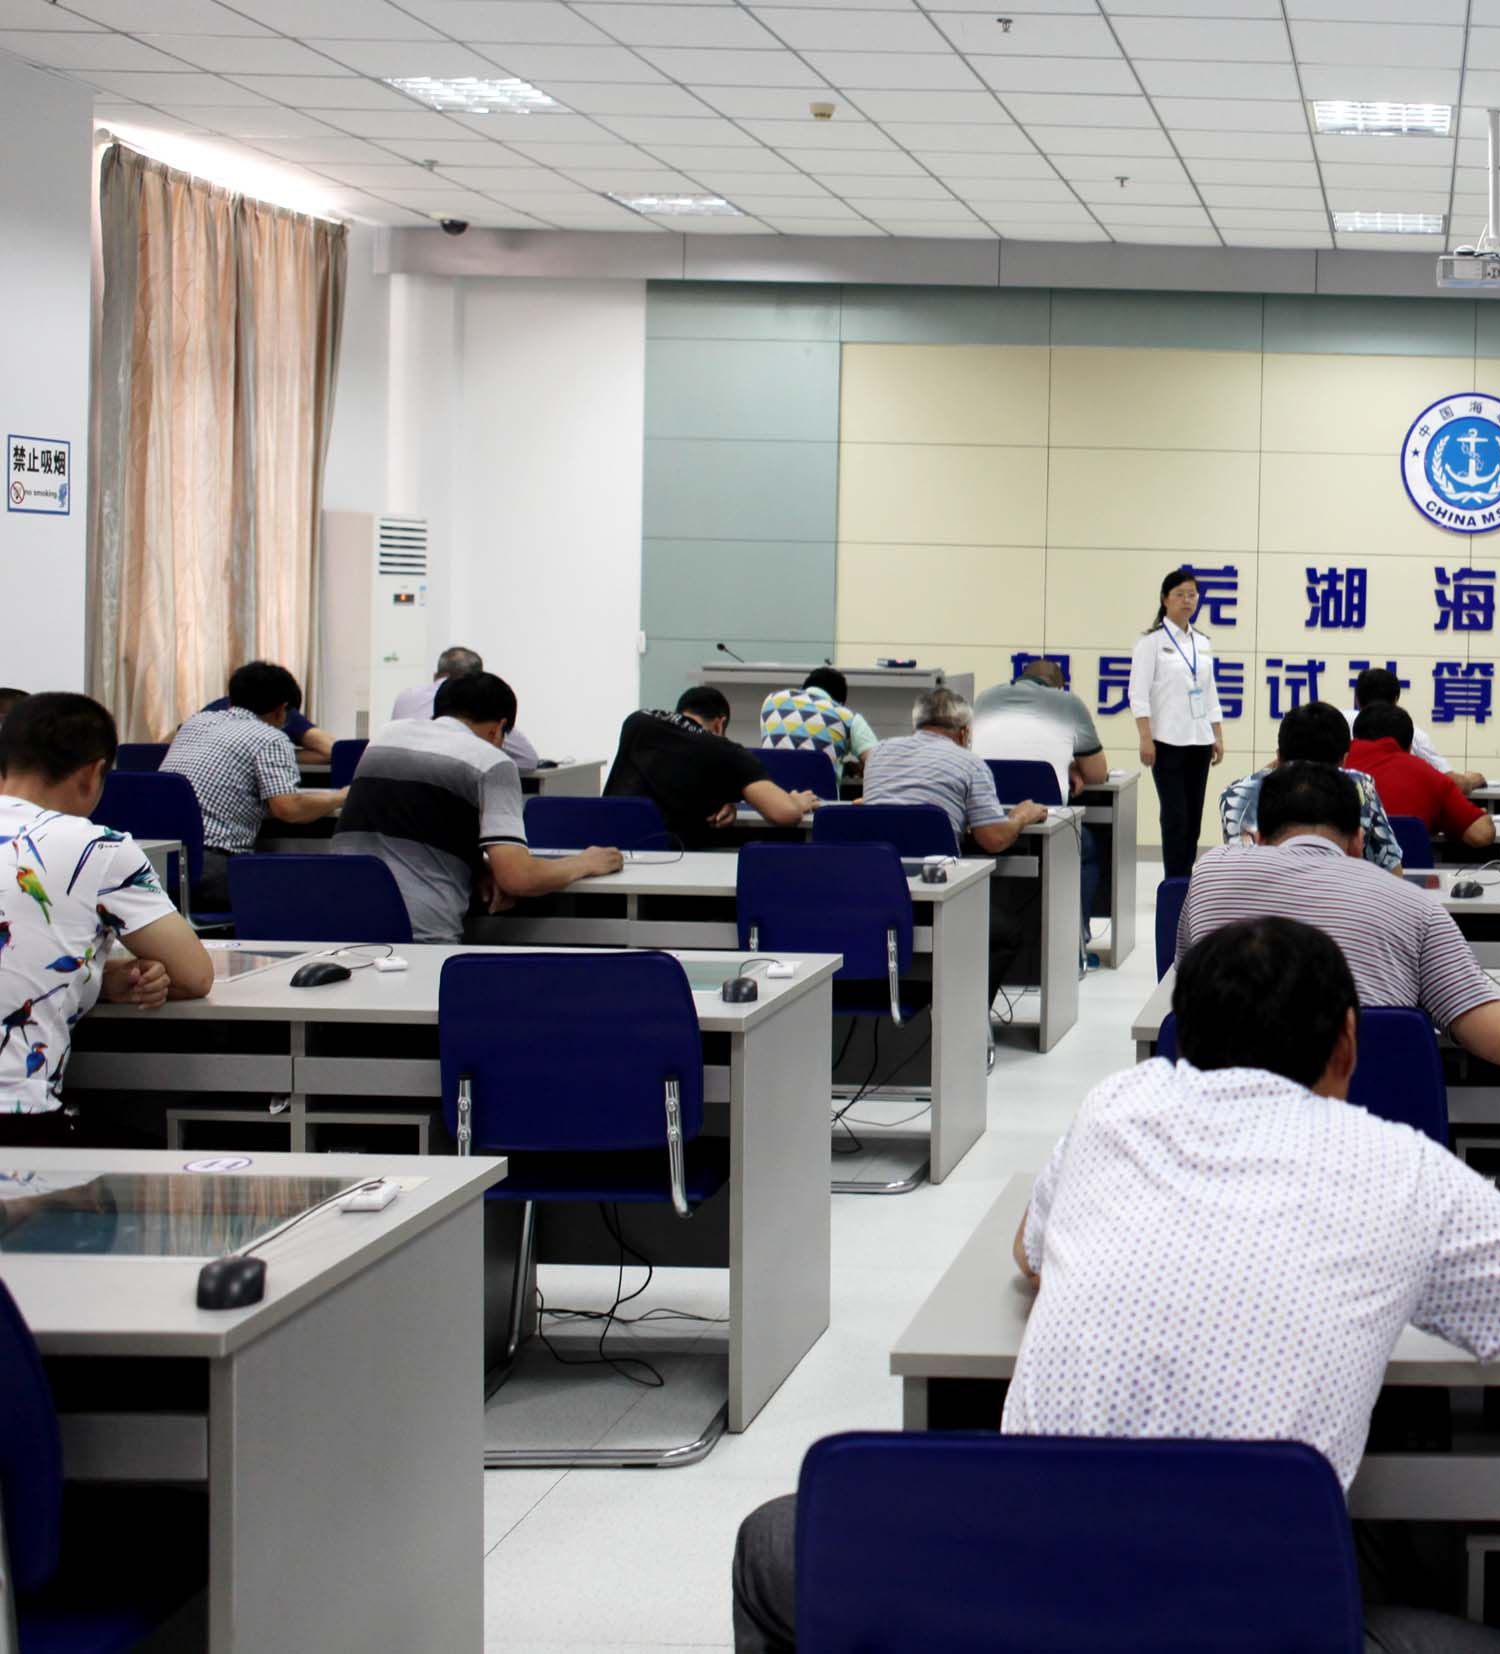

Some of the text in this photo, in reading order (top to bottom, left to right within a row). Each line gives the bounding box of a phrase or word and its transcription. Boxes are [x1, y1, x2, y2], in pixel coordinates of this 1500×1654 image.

[13, 445, 66, 476] 禁止吸烟
[1426, 500, 1477, 527] CHINA
